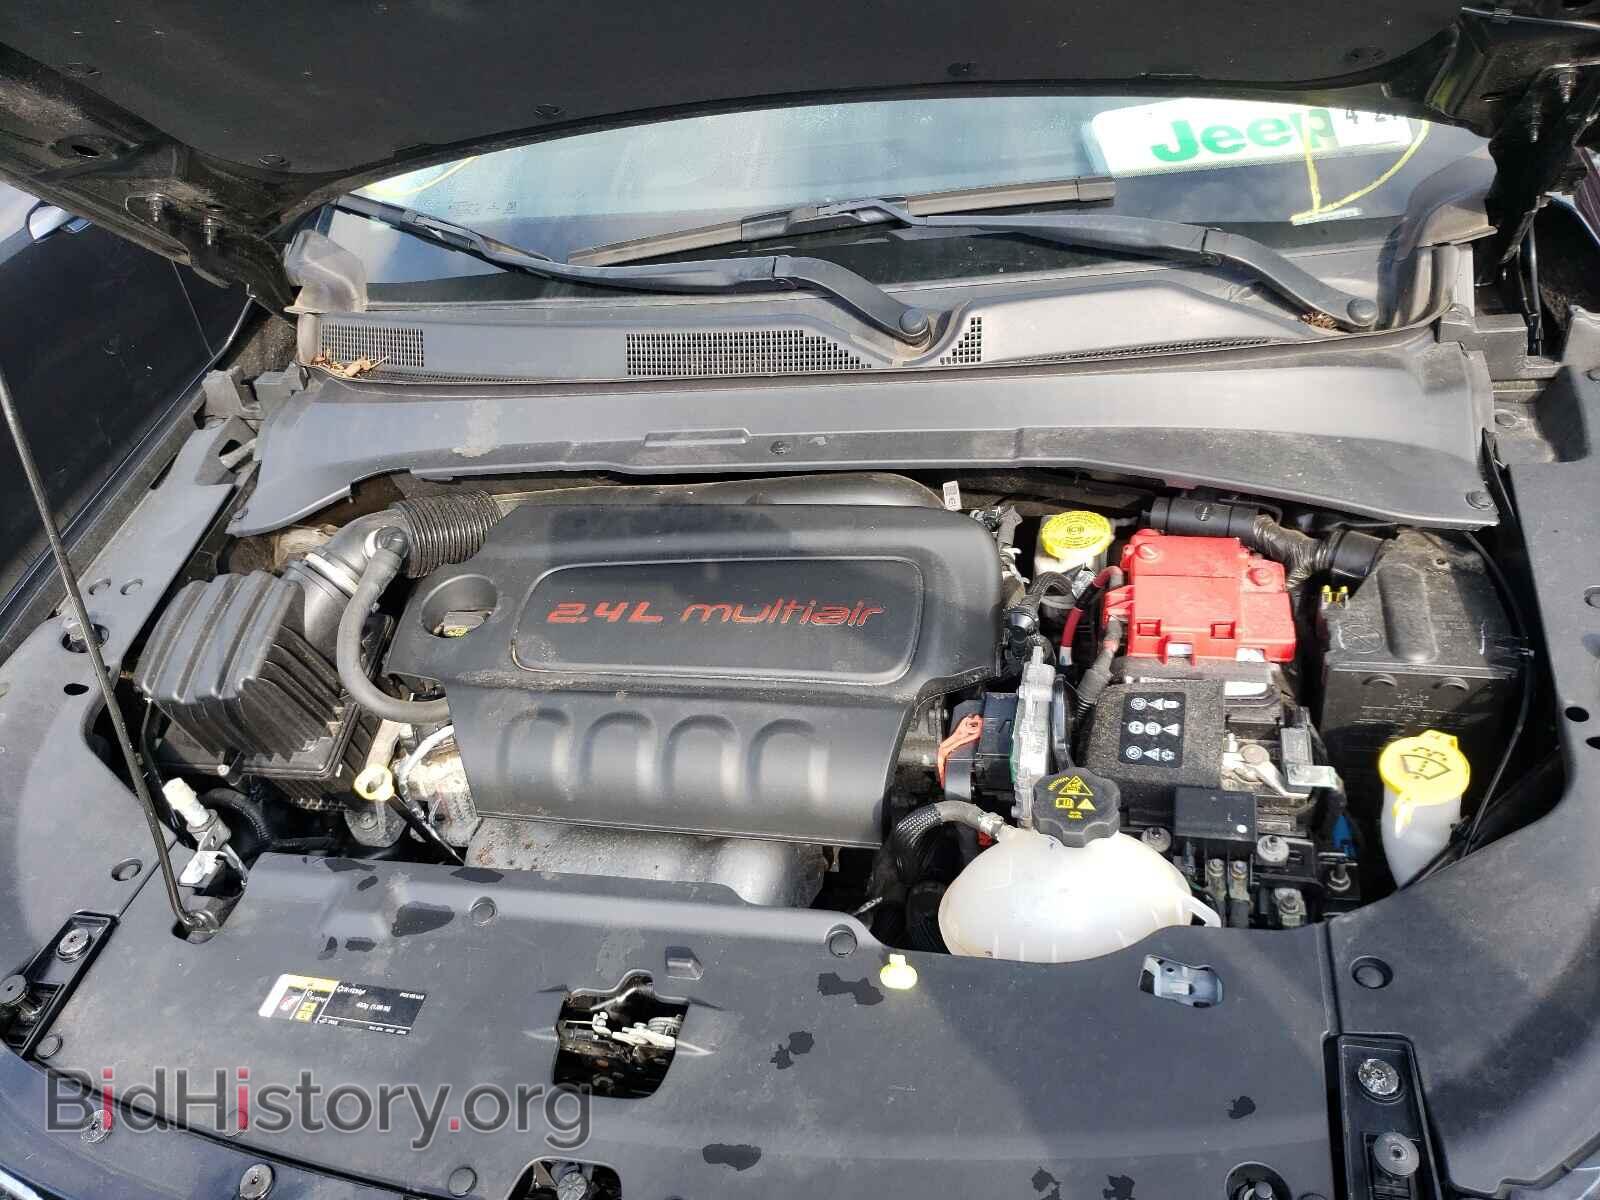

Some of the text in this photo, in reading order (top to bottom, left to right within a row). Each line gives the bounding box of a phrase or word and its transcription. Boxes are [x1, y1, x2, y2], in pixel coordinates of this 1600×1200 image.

[1150, 109, 1336, 162] Jeep
[546, 598, 885, 627] 2.4L multiair
